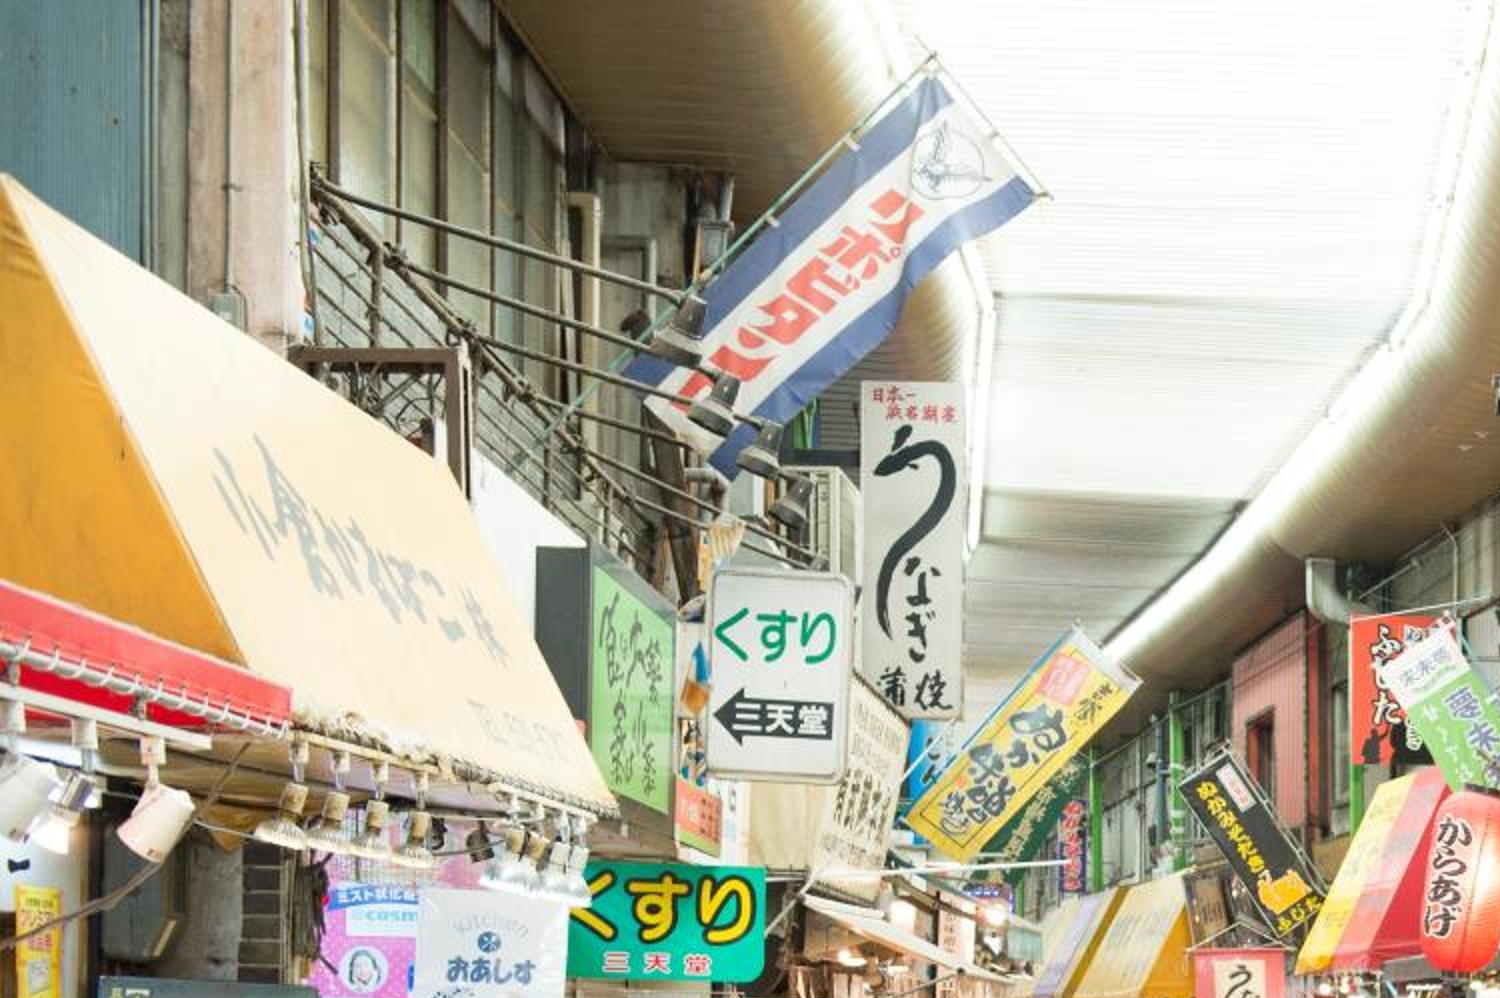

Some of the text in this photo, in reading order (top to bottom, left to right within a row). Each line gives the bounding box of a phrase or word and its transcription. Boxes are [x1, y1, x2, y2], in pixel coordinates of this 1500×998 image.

[873, 424, 956, 663] うなぎ
[714, 607, 838, 665] くすり
[877, 666, 952, 710] 蒲焼
[732, 703, 829, 737] 三天堂
[1424, 815, 1473, 938] からあげ
[570, 870, 756, 944] くすり
[447, 955, 536, 986] おあしす
[603, 952, 711, 976] 三天堂
